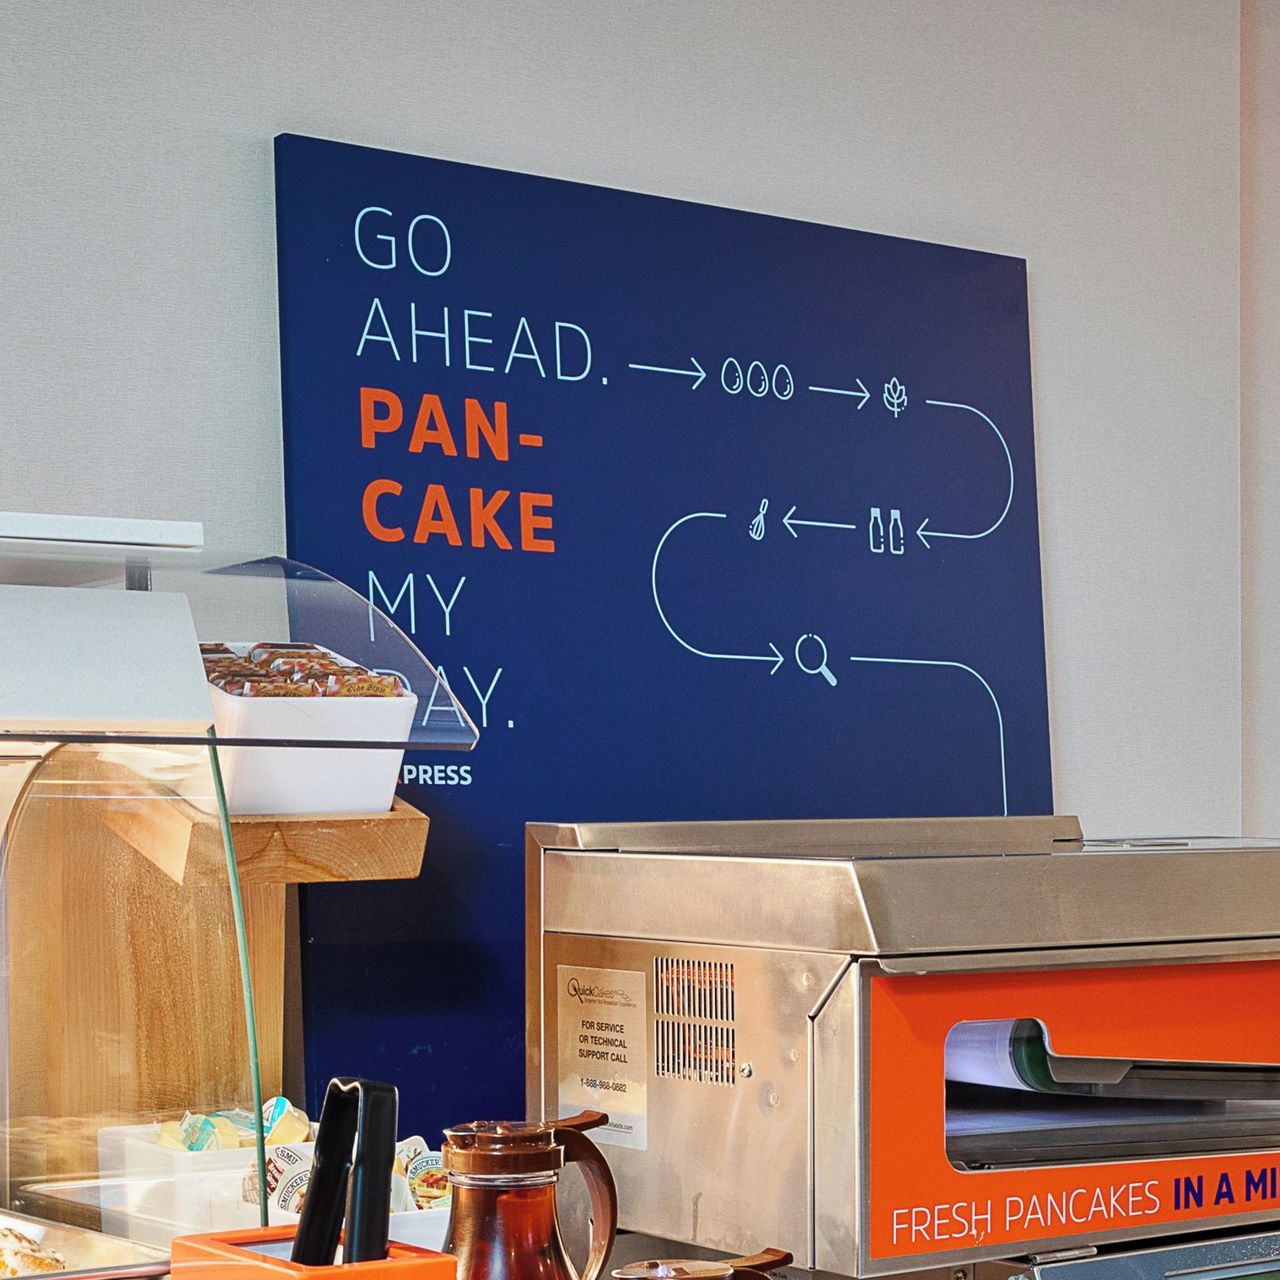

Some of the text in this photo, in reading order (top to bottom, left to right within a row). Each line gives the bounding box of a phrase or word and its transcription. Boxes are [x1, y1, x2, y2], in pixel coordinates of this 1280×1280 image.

[354, 206, 451, 277] GO
[356, 297, 608, 385] AHEAD.
[359, 386, 543, 462] PAN-
[361, 478, 555, 553] CAKE
[369, 570, 466, 642] MY
[399, 765, 472, 785] PRESS
[578, 1034, 628, 1049] OR TECHNICAL
[578, 1049, 628, 1064] SUPPORT CALL
[581, 1020, 625, 1034] FOR SERVICE
[893, 1199, 992, 1245] FRESH
[1005, 1180, 1160, 1231] PANCAKES
[1174, 1175, 1203, 1210] IN
[1213, 1172, 1235, 1205] A
